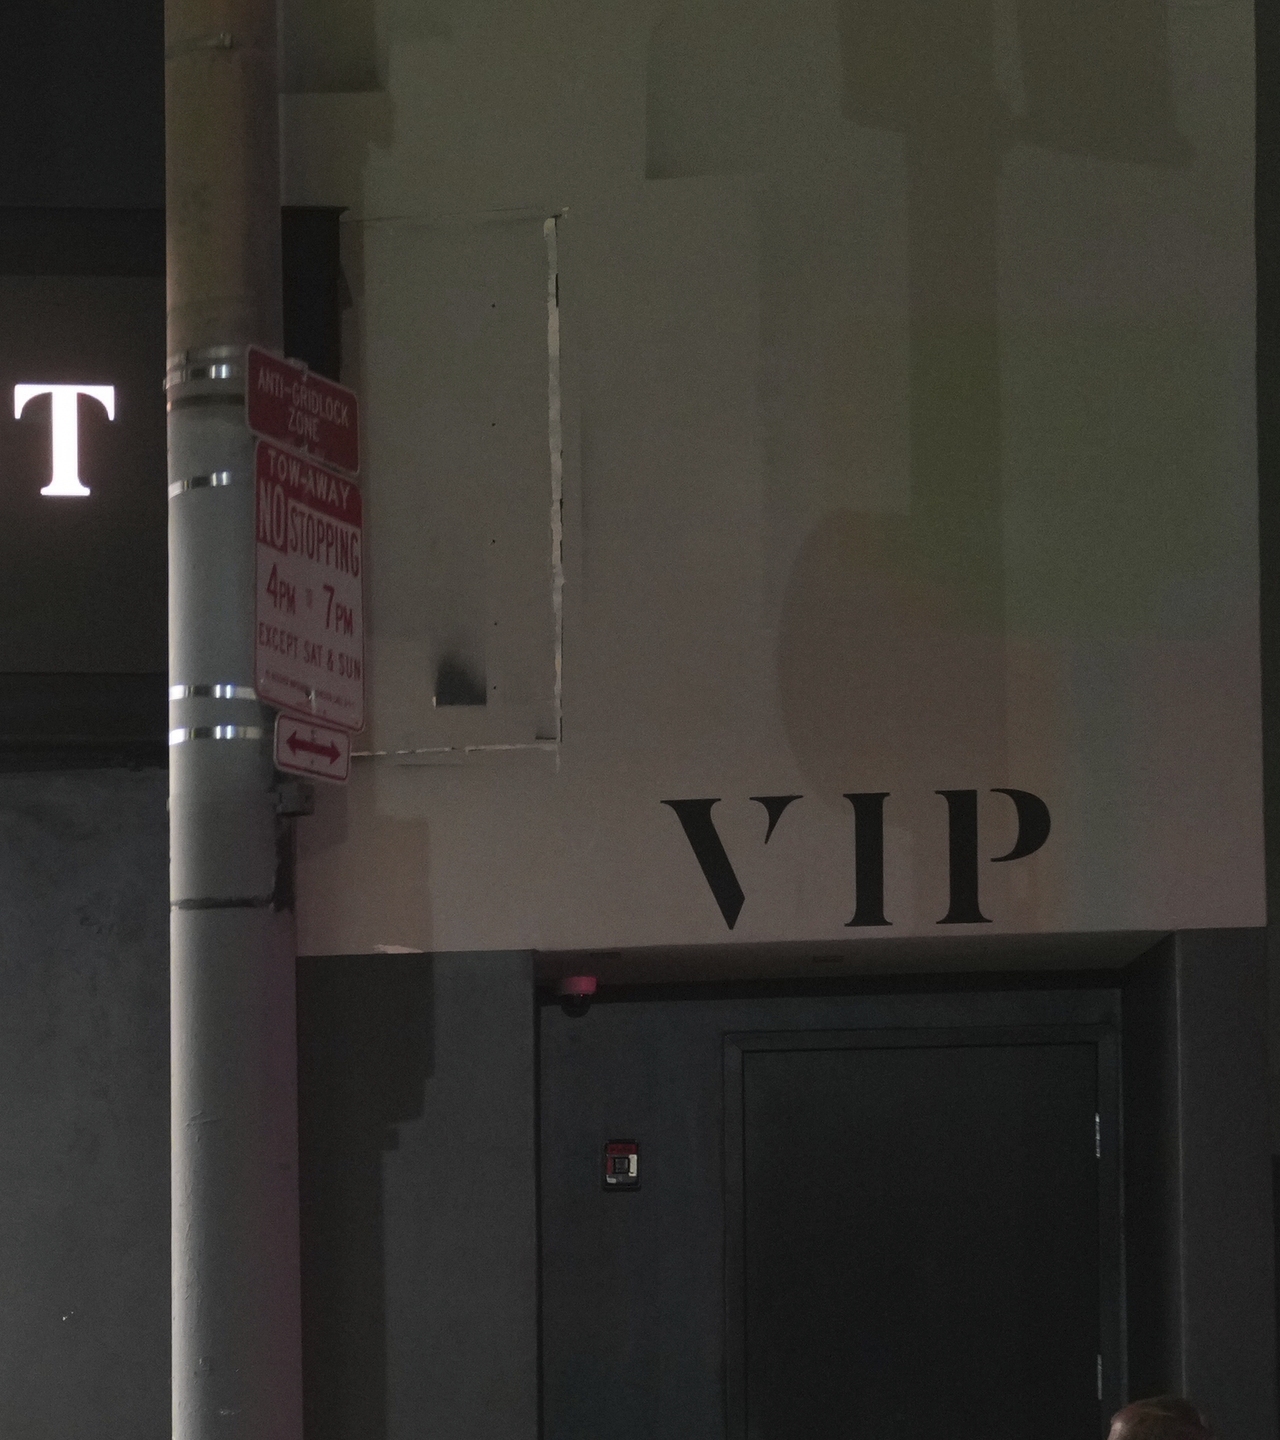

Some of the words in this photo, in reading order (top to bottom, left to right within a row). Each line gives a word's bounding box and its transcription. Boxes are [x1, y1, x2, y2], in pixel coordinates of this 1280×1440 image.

[258, 367, 349, 429] ANTI-GRIDLOCK
[288, 407, 320, 443] ZONE
[268, 448, 351, 509] TOW-AWAY
[259, 478, 285, 547] NO
[290, 505, 359, 577] STOPPING
[259, 622, 298, 660] EXCEPT
[304, 640, 323, 667] SAT
[326, 650, 334, 672] &
[338, 652, 361, 681] SUN
[660, 788, 1052, 930] VIP
